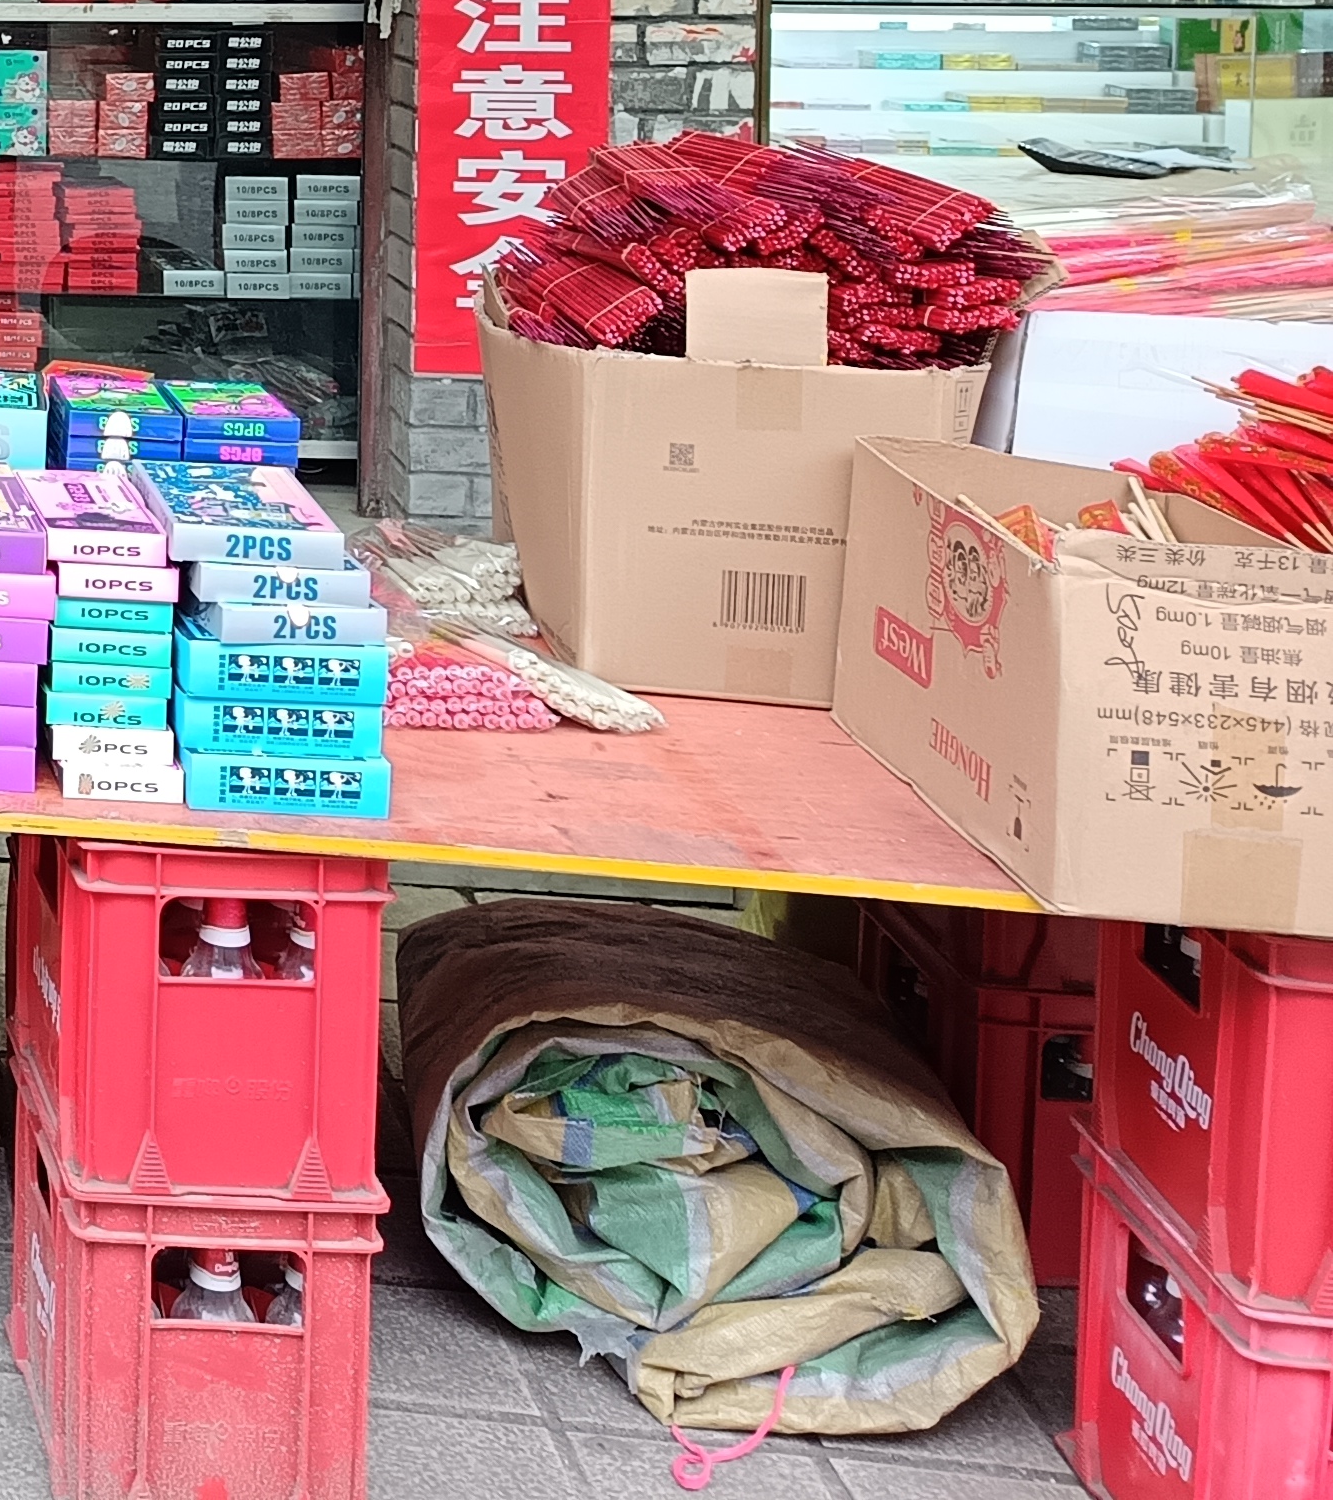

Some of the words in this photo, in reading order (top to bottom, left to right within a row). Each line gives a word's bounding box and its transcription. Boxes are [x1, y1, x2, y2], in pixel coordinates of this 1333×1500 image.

[226, 534, 292, 561] 2PCS
[253, 575, 319, 600] 2PCS
[1156, 606, 1212, 627] 1.0mg
[1220, 612, 1327, 636] 烟气烟碱量
[1181, 641, 1231, 660] 10mg
[1240, 645, 1302, 667] 焦油量
